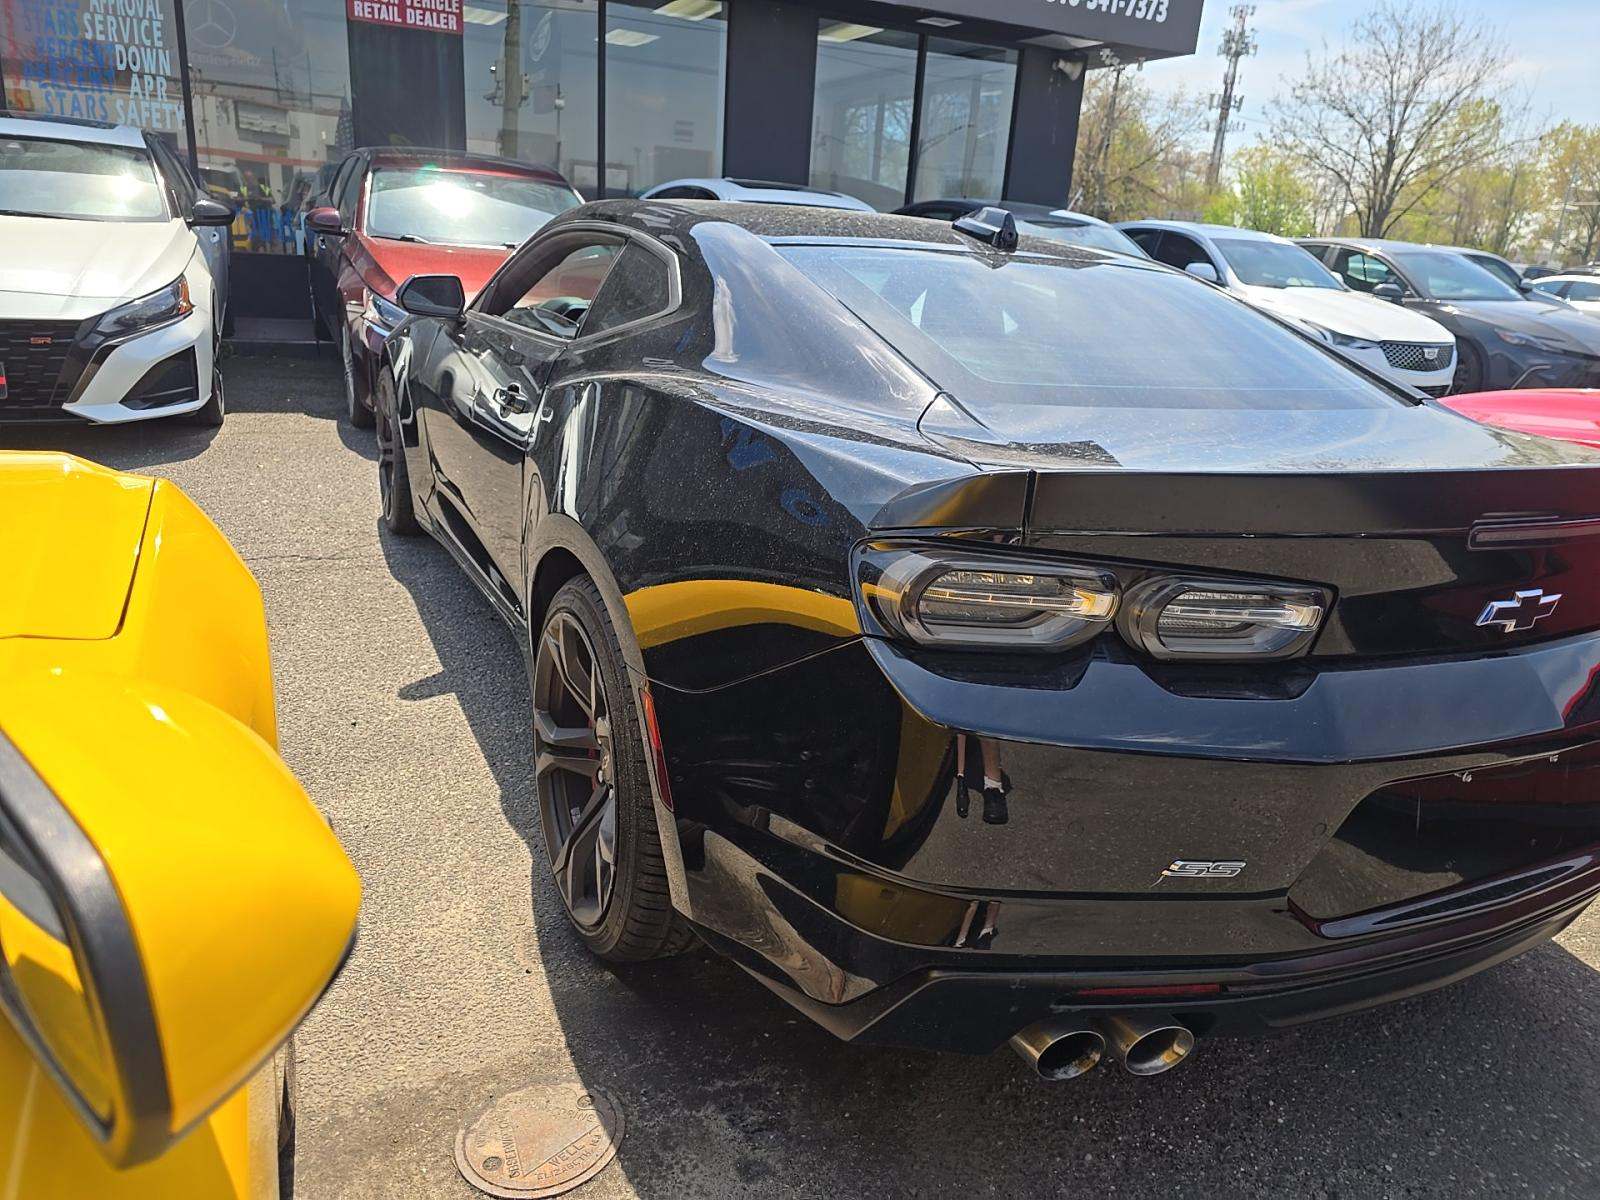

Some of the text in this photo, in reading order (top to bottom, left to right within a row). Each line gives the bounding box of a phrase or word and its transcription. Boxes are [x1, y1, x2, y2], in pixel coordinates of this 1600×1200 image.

[83, 11, 163, 47] SERVICE
[354, 1, 457, 31] RETAIL DEALER
[115, 45, 171, 76] DOWN
[129, 73, 168, 101] APR
[44, 89, 186, 130] STARS SAFETY
[1161, 860, 1247, 878] SS
[548, 1143, 586, 1167] WELL
